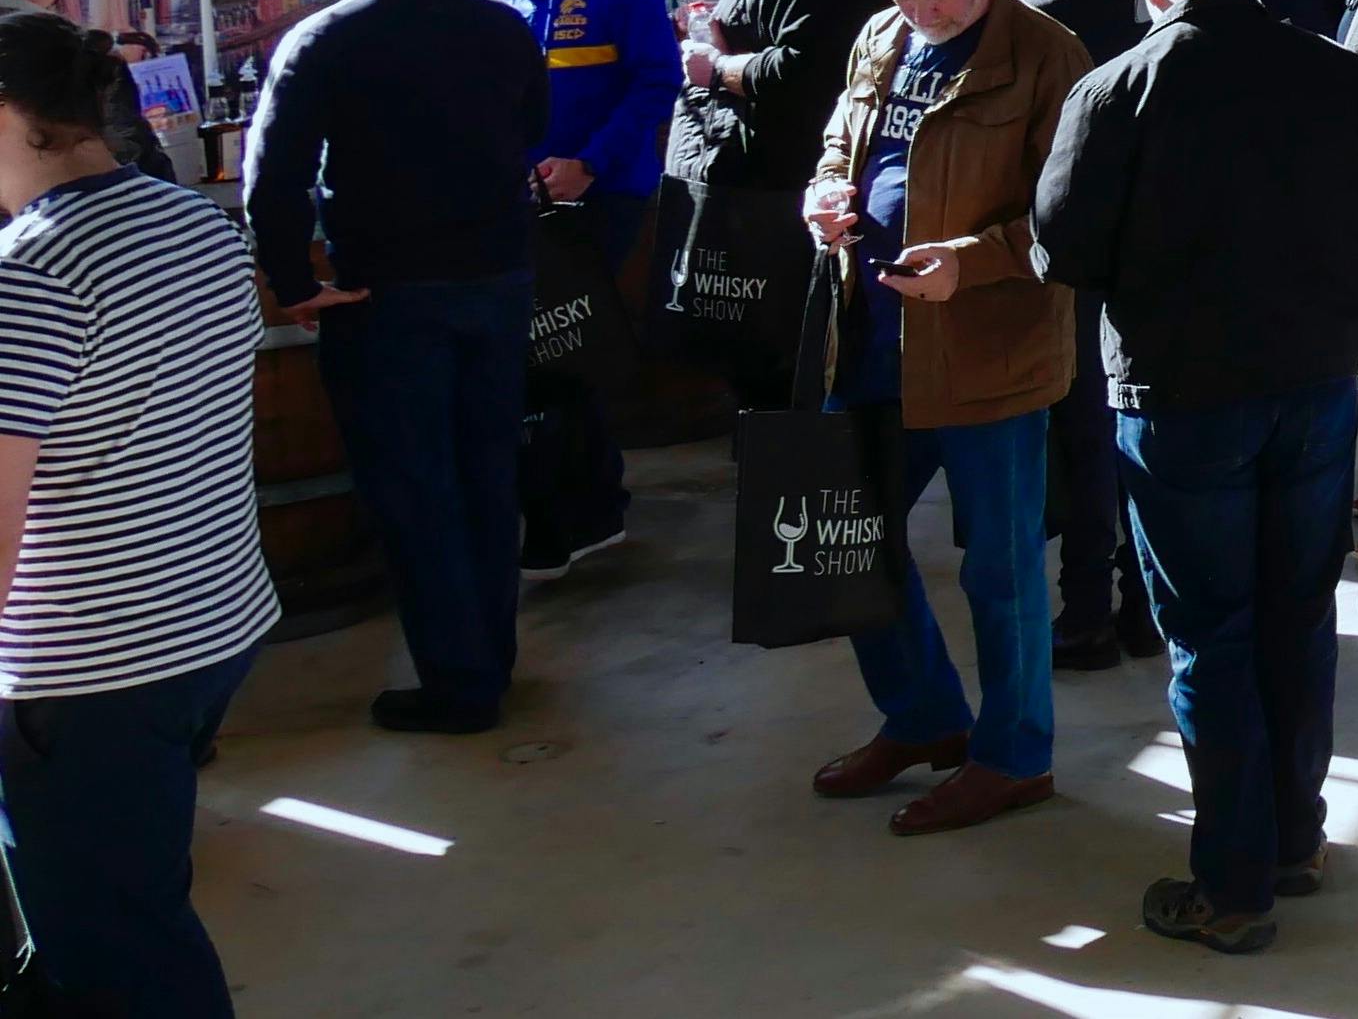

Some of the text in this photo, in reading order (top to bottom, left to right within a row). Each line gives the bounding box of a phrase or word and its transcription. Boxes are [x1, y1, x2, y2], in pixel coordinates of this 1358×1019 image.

[696, 248, 727, 272] THE
[694, 272, 768, 300] WHISKY
[692, 297, 745, 322] SHOW
[819, 489, 862, 515] THE
[814, 547, 876, 576] SHOW
